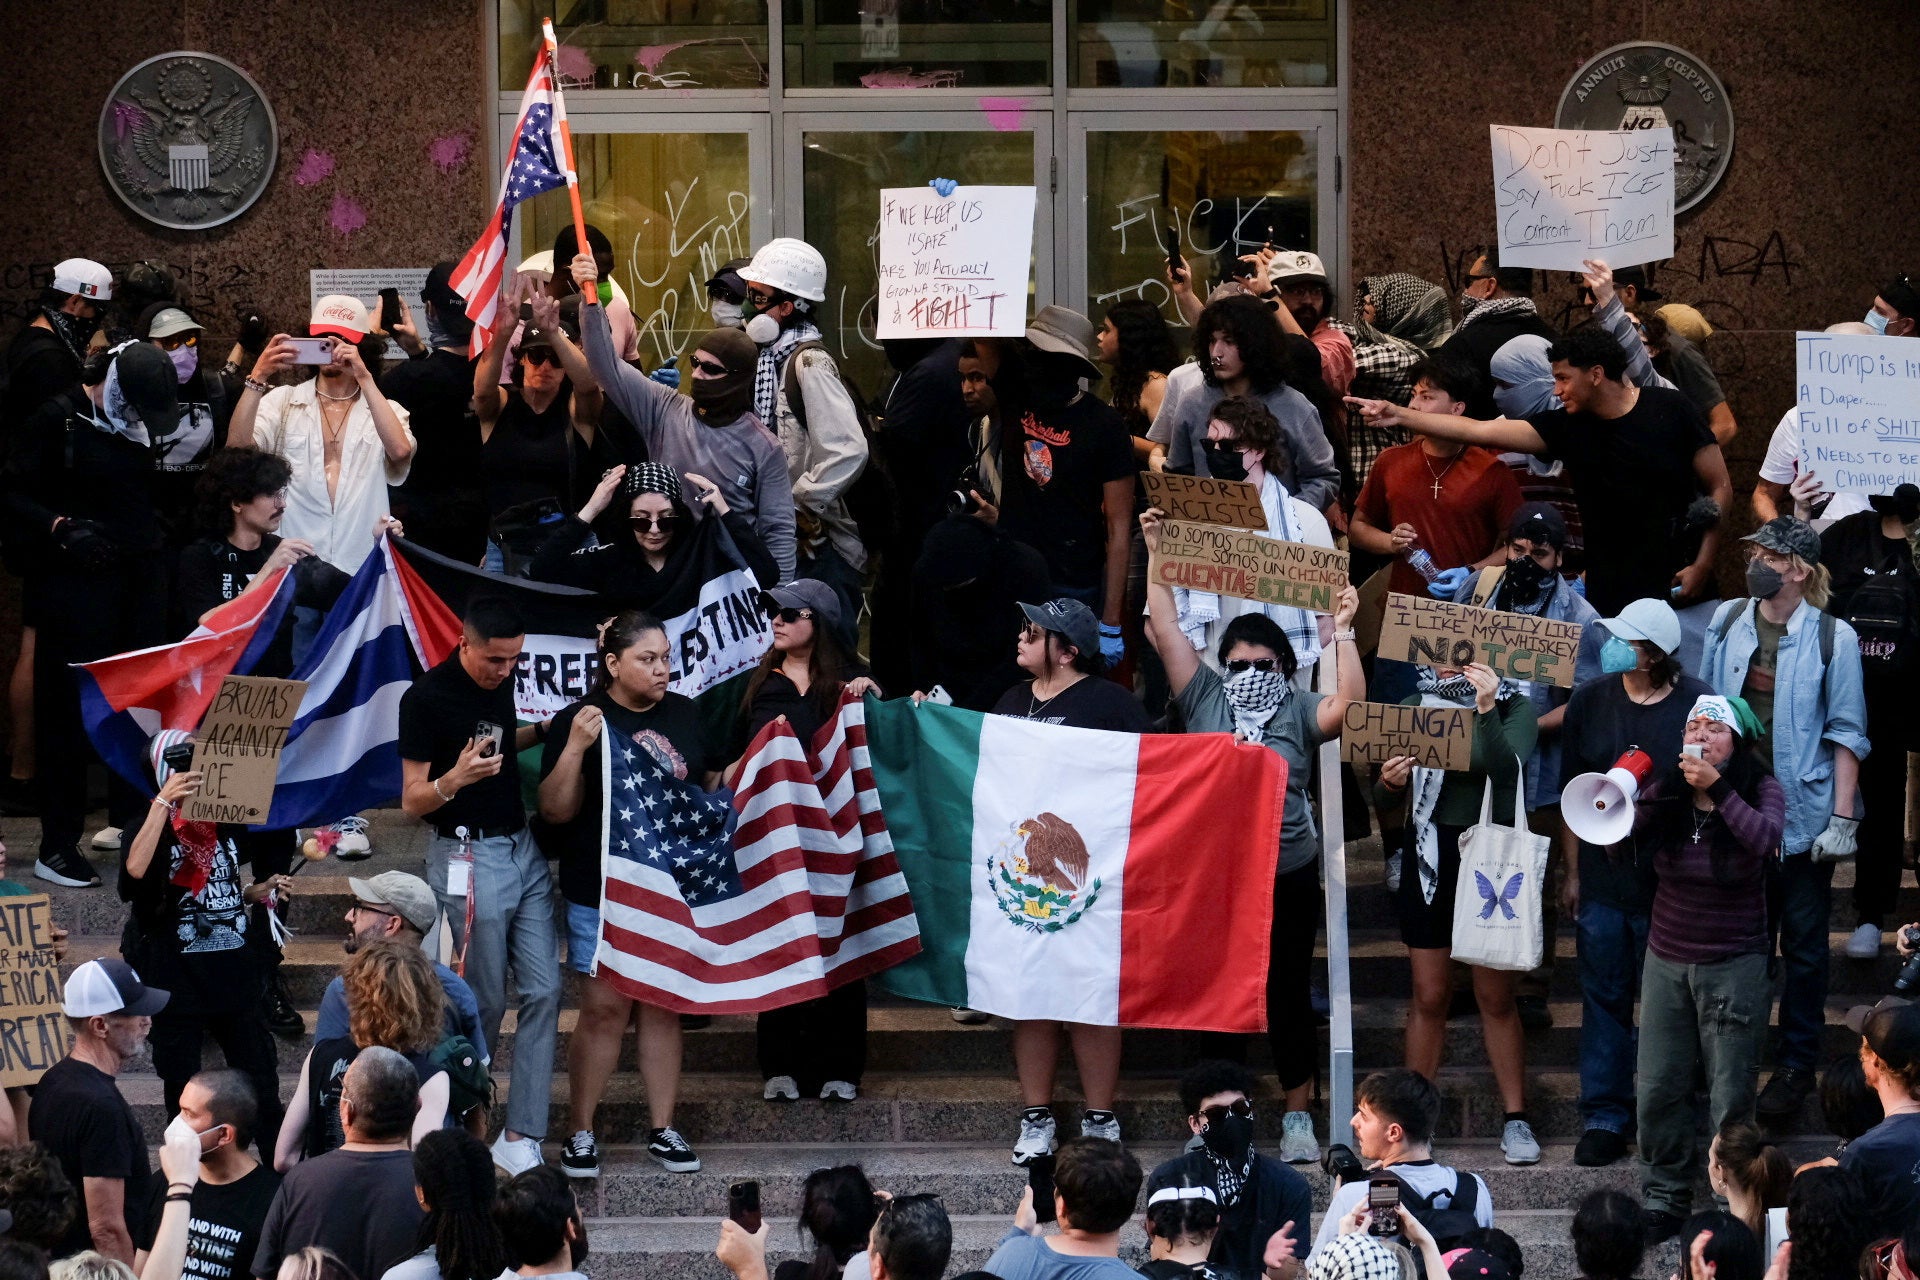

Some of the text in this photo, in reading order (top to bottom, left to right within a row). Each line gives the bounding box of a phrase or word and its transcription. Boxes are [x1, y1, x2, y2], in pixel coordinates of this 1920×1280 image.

[1575, 55, 1626, 103] ANNUIT
[1497, 127, 1592, 171] Don't
[1600, 132, 1668, 166] Just
[1500, 174, 1540, 208] Say
[883, 195, 983, 229] IF WE KEEP US
[1111, 193, 1290, 257] FUCK
[1504, 209, 1572, 246] Confront
[880, 264, 907, 279] ARE
[914, 259, 931, 275] YOU
[932, 282, 979, 296] STAND
[908, 292, 1008, 331] FIGHT
[1797, 337, 1874, 384] Trump
[1879, 354, 1896, 377] is
[1800, 383, 1811, 403] A
[1800, 411, 1839, 435] Full
[1847, 417, 1871, 434] of
[1816, 445, 1865, 465] NEEDS
[1867, 452, 1893, 465] TO
[1898, 453, 1919, 465] BE
[1145, 474, 1250, 500] DEPORT
[1151, 494, 1267, 529] RACISTS
[1160, 521, 1180, 538] NO
[1285, 545, 1305, 563] NO
[1159, 560, 1246, 595] CUENTA
[1257, 576, 1331, 611] BIEN
[1264, 560, 1285, 577] UN
[1388, 594, 1583, 641] I LIKE MY CITY LIKE
[1394, 612, 1411, 627] I
[1416, 614, 1468, 634] LIKE
[1471, 624, 1500, 643] MY
[1407, 633, 1560, 686] NO ICE
[1857, 635, 1896, 660] uicy
[214, 680, 294, 720] BRUJAS
[1344, 701, 1465, 739] CHINGA
[202, 722, 291, 759] AGAINST
[1350, 738, 1450, 769] MIGRA!
[1380, 733, 1411, 749] TU
[0, 901, 53, 950] ATE
[18, 949, 58, 969] MADE
[0, 970, 65, 1007] ERICA
[0, 1012, 71, 1072] REAT
[188, 1217, 242, 1244] AND WITH
[200, 1260, 232, 1279] WITH
